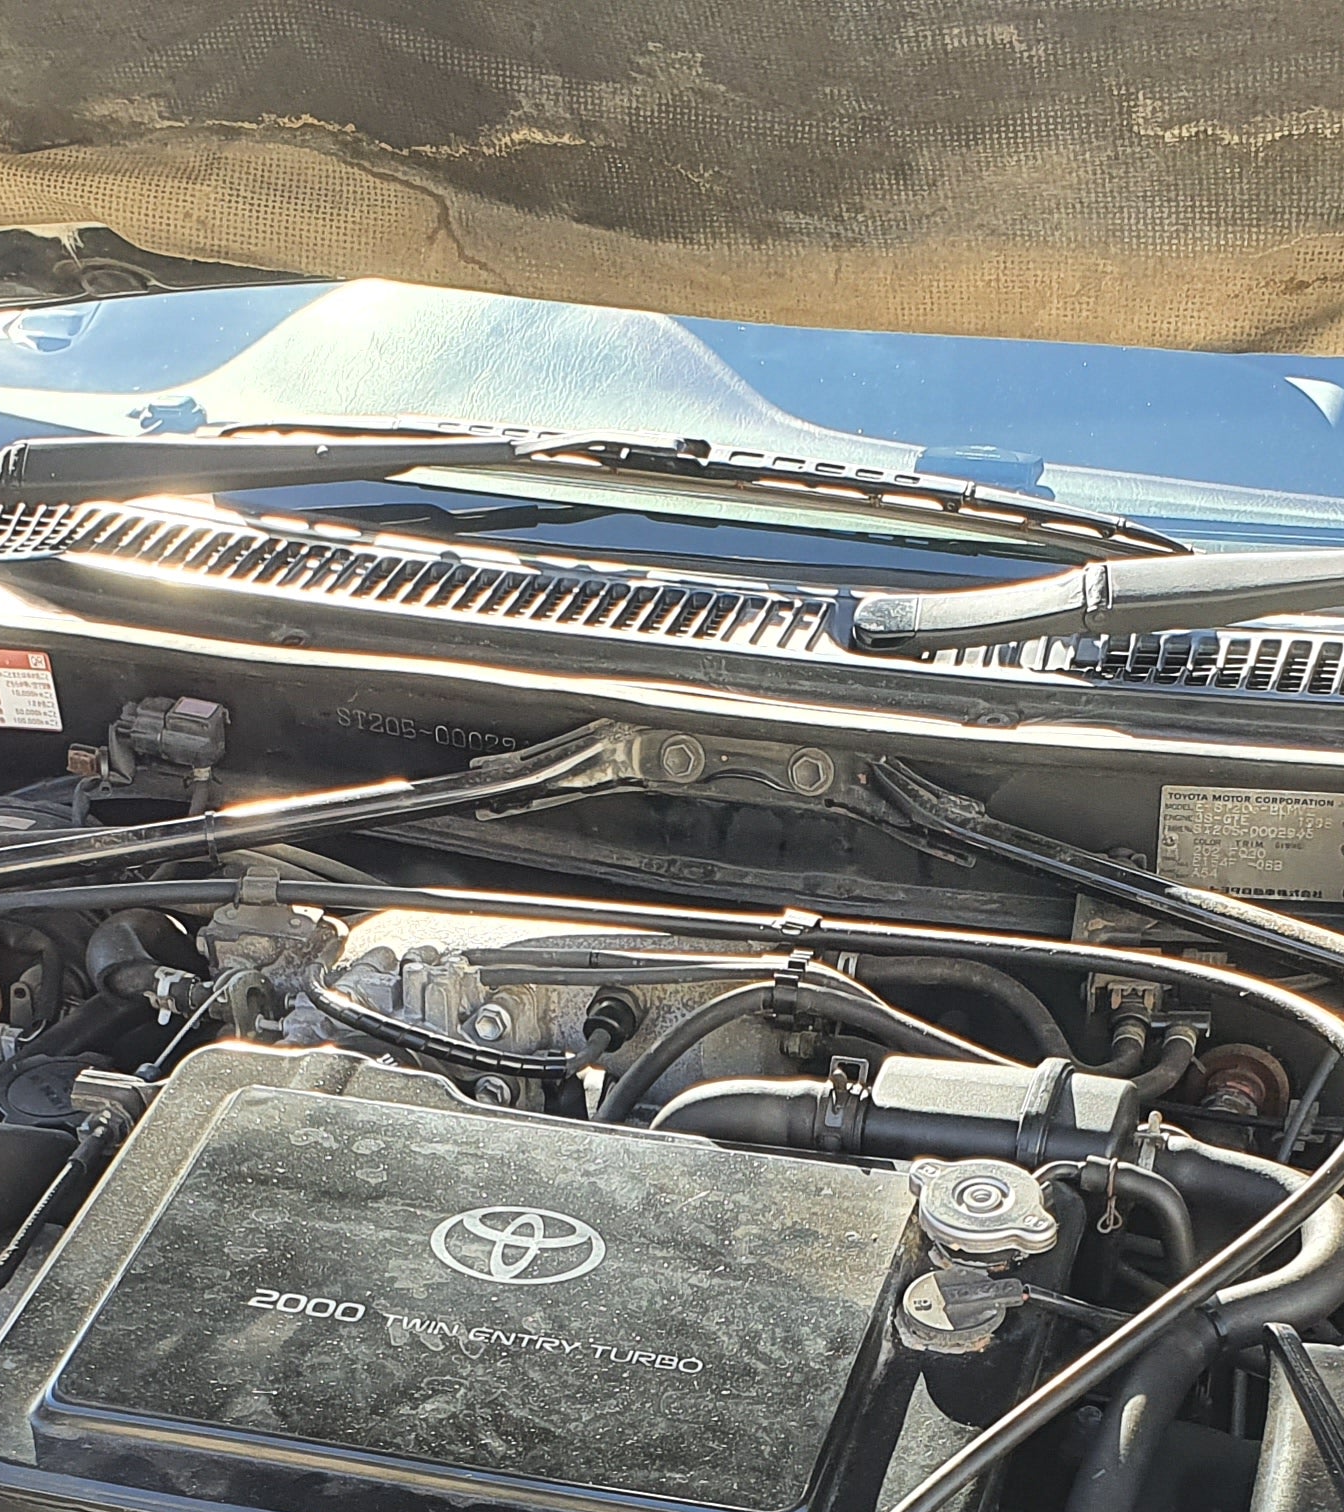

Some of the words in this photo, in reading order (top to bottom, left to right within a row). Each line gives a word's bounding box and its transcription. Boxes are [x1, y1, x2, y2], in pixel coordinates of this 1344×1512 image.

[1168, 792, 1208, 801] TOYOTA
[1212, 794, 1251, 803] MOTOR
[1255, 796, 1334, 807] CORPORATION
[1235, 840, 1264, 848] TRIM
[248, 1287, 367, 1325] 2000
[382, 1313, 460, 1341] TWIN
[466, 1326, 583, 1356] ENTRY
[588, 1341, 704, 1375] TURBO
